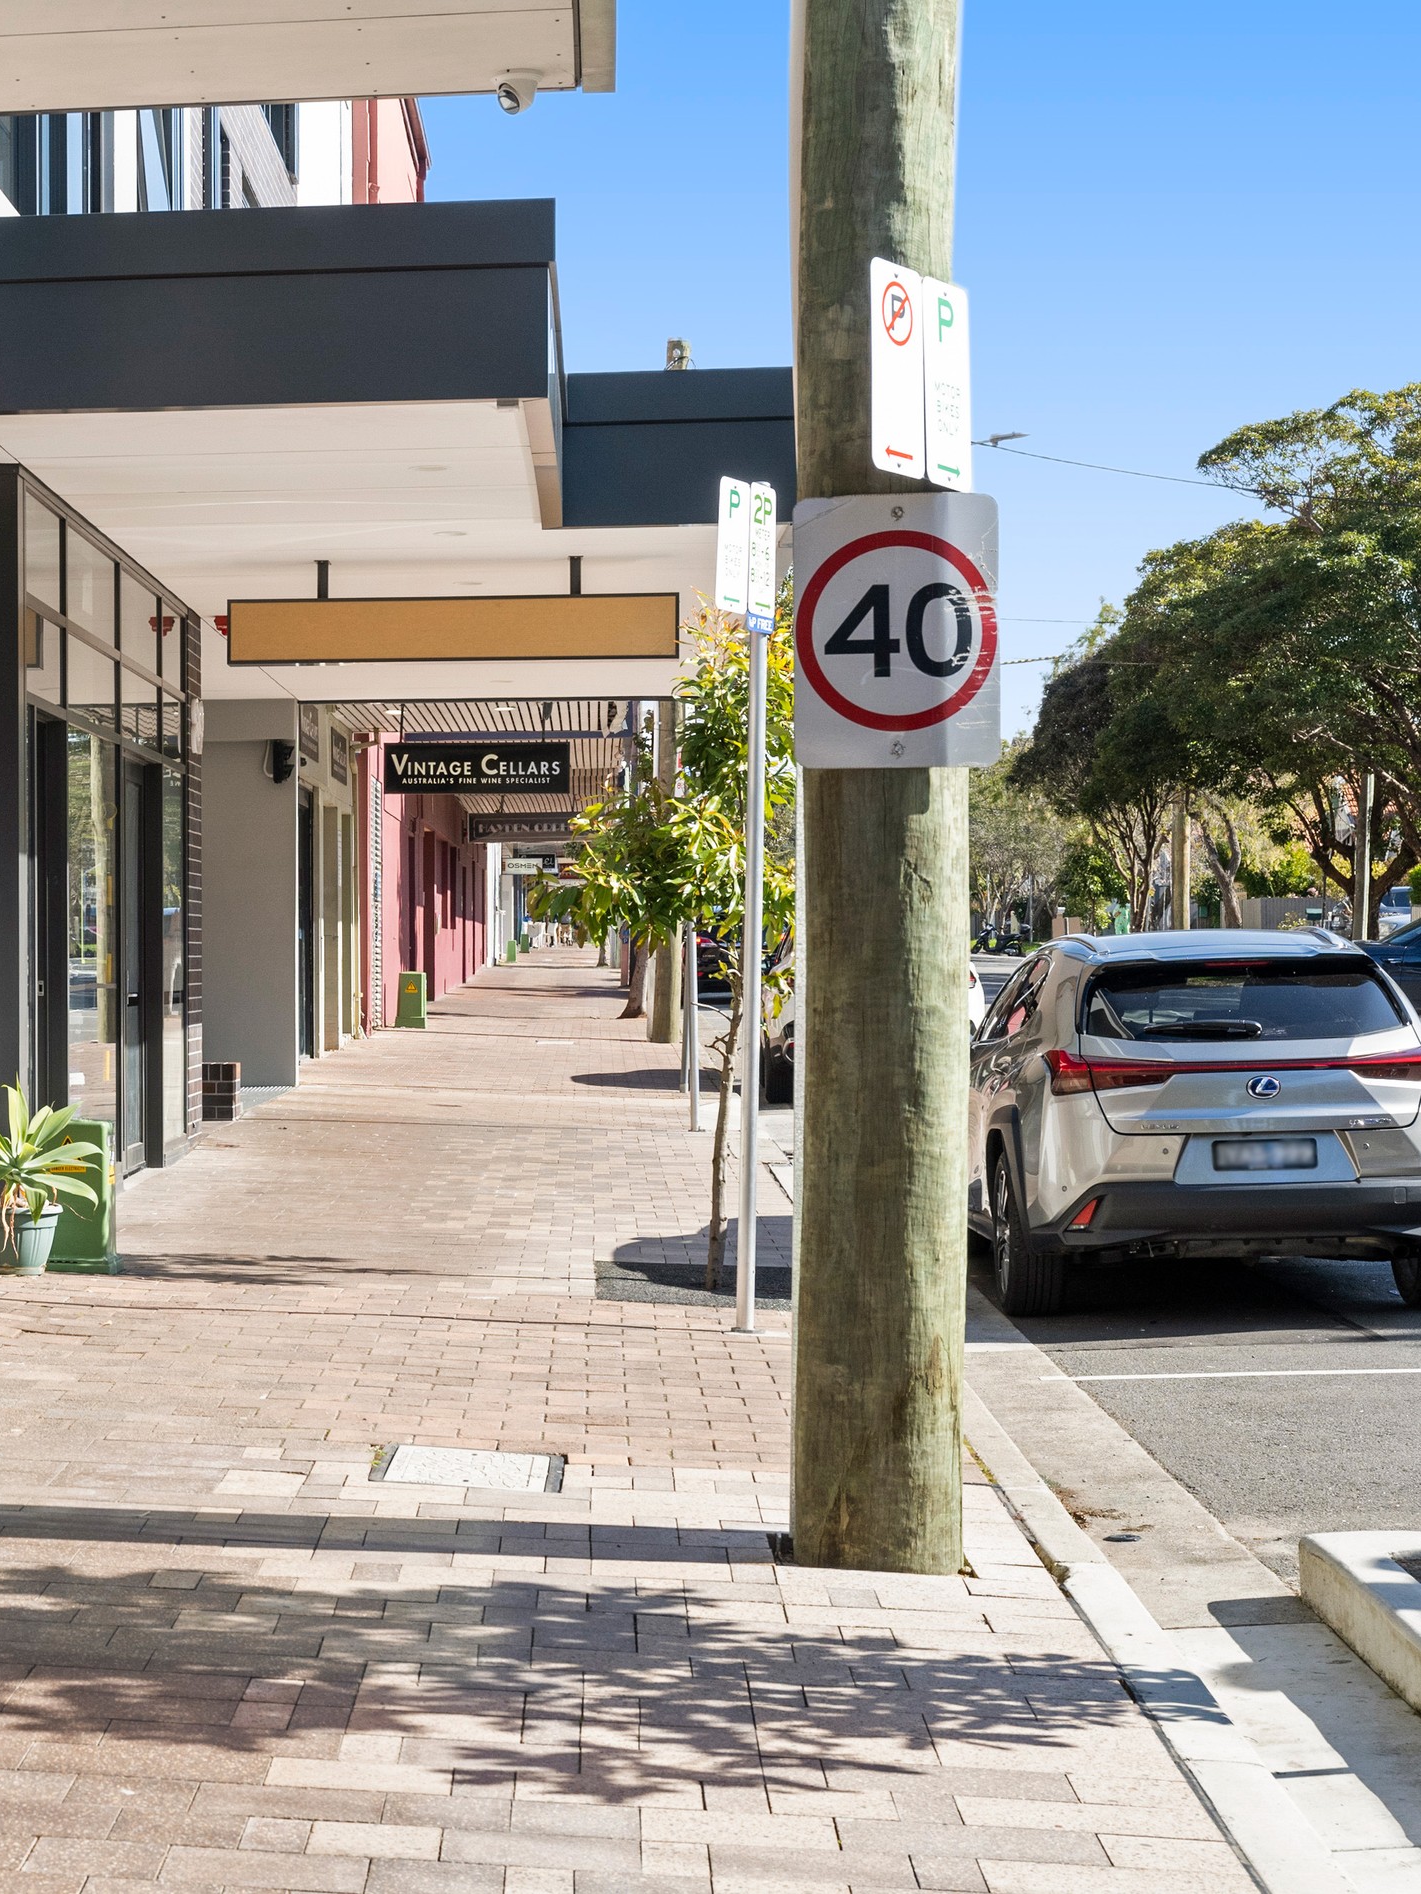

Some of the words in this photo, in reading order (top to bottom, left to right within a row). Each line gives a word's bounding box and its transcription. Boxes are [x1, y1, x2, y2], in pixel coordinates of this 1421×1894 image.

[937, 297, 954, 342] P
[729, 489, 741, 518] P
[754, 494, 773, 525] 2P
[757, 617, 773, 631] FREE
[824, 582, 972, 678] 40
[479, 823, 530, 833] HAYDEN
